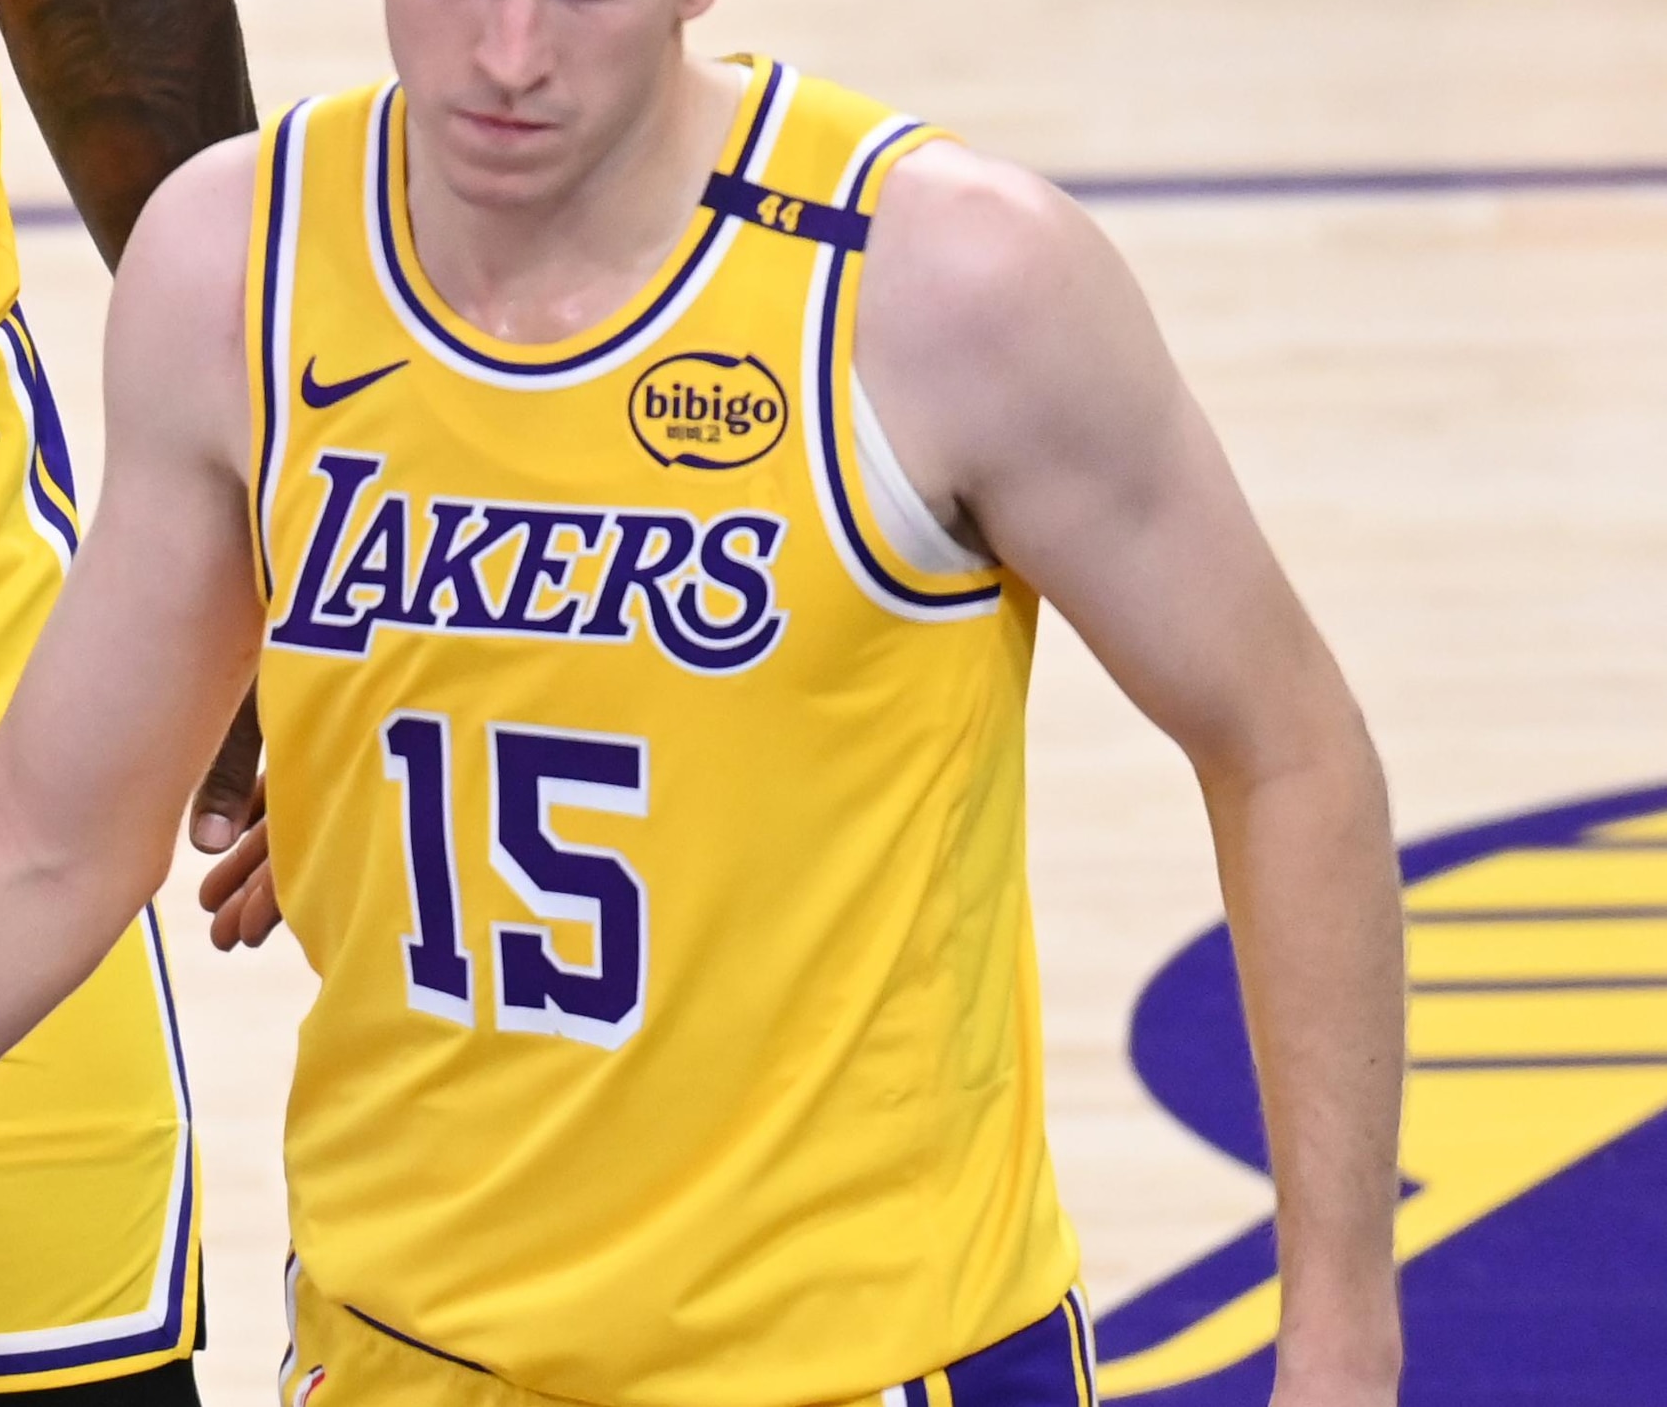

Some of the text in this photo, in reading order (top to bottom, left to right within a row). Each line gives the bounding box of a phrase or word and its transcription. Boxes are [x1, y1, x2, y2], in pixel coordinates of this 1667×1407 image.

[757, 194, 805, 233] 44
[645, 382, 777, 435] bibigo
[263, 446, 790, 676] LAKERS
[378, 707, 650, 1052] 15
